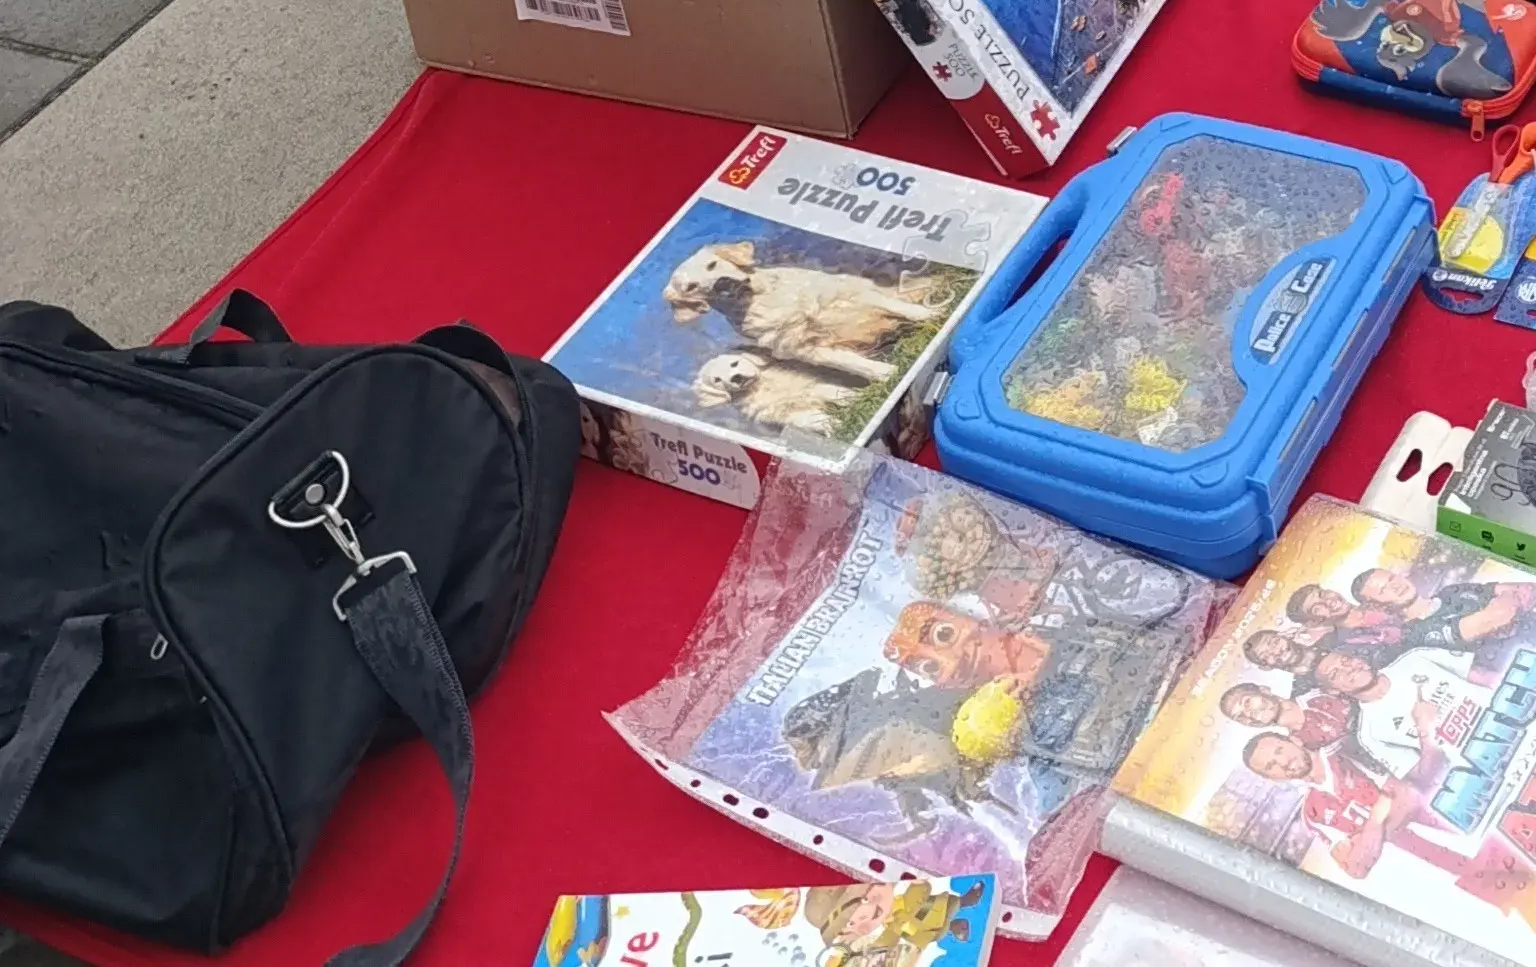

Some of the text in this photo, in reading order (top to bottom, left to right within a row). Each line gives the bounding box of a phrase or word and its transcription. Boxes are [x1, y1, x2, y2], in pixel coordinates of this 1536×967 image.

[946, 52, 966, 78] 500
[947, 41, 978, 79] PUZZLE
[975, 23, 1032, 101] PUZZLE
[743, 133, 777, 170] Trefl
[995, 123, 1023, 156] Trefl
[857, 167, 916, 195] 500
[777, 177, 954, 241] Trefl Puzzle
[1447, 272, 1498, 291] Pelikan
[1252, 310, 1291, 355] Police
[650, 432, 749, 474] Trefl Puzzle
[677, 459, 722, 486] 500
[803, 530, 884, 637] BRAINROT
[1436, 695, 1477, 746] topps
